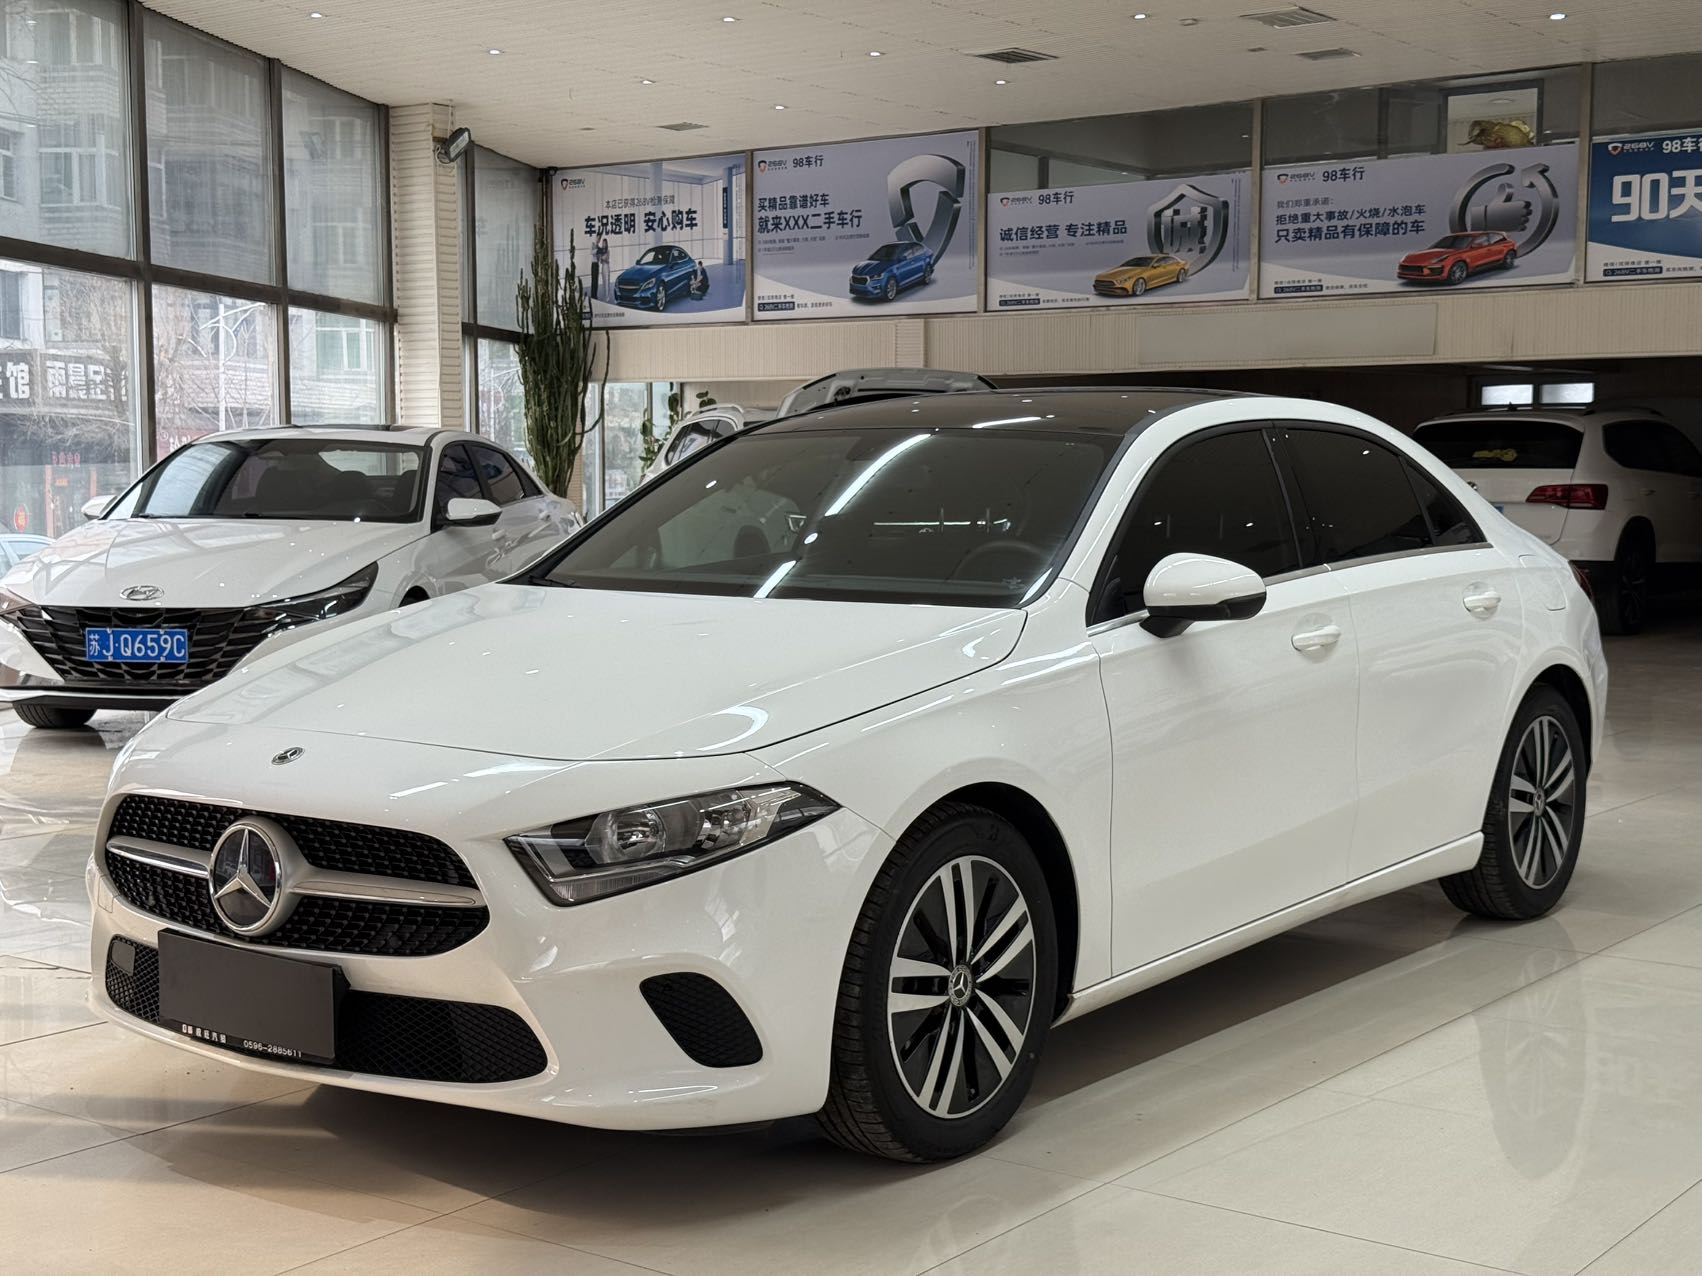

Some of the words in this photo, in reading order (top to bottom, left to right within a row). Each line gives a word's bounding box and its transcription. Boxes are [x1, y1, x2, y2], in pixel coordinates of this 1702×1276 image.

[1662, 137, 1702, 153] 98车
[792, 155, 824, 168] 98车行
[1322, 166, 1365, 182] 98车行
[758, 193, 830, 212] 买精品靠谱好车
[1038, 191, 1074, 205] 98车行
[1611, 169, 1702, 222] 90天
[584, 213, 636, 237] 车况透明
[644, 208, 698, 233] 安心购车
[757, 209, 862, 233] 就来XXX二手车行
[1275, 204, 1426, 225] 拒绝重大事故/火烧/水泡车
[999, 224, 1060, 241] 诚信经营
[1065, 220, 1127, 237] 专注精品
[1275, 220, 1425, 243] 只卖精品有保障的车
[0, 362, 30, 399] 馆
[89, 634, 185, 657] 苏J·Q659C
